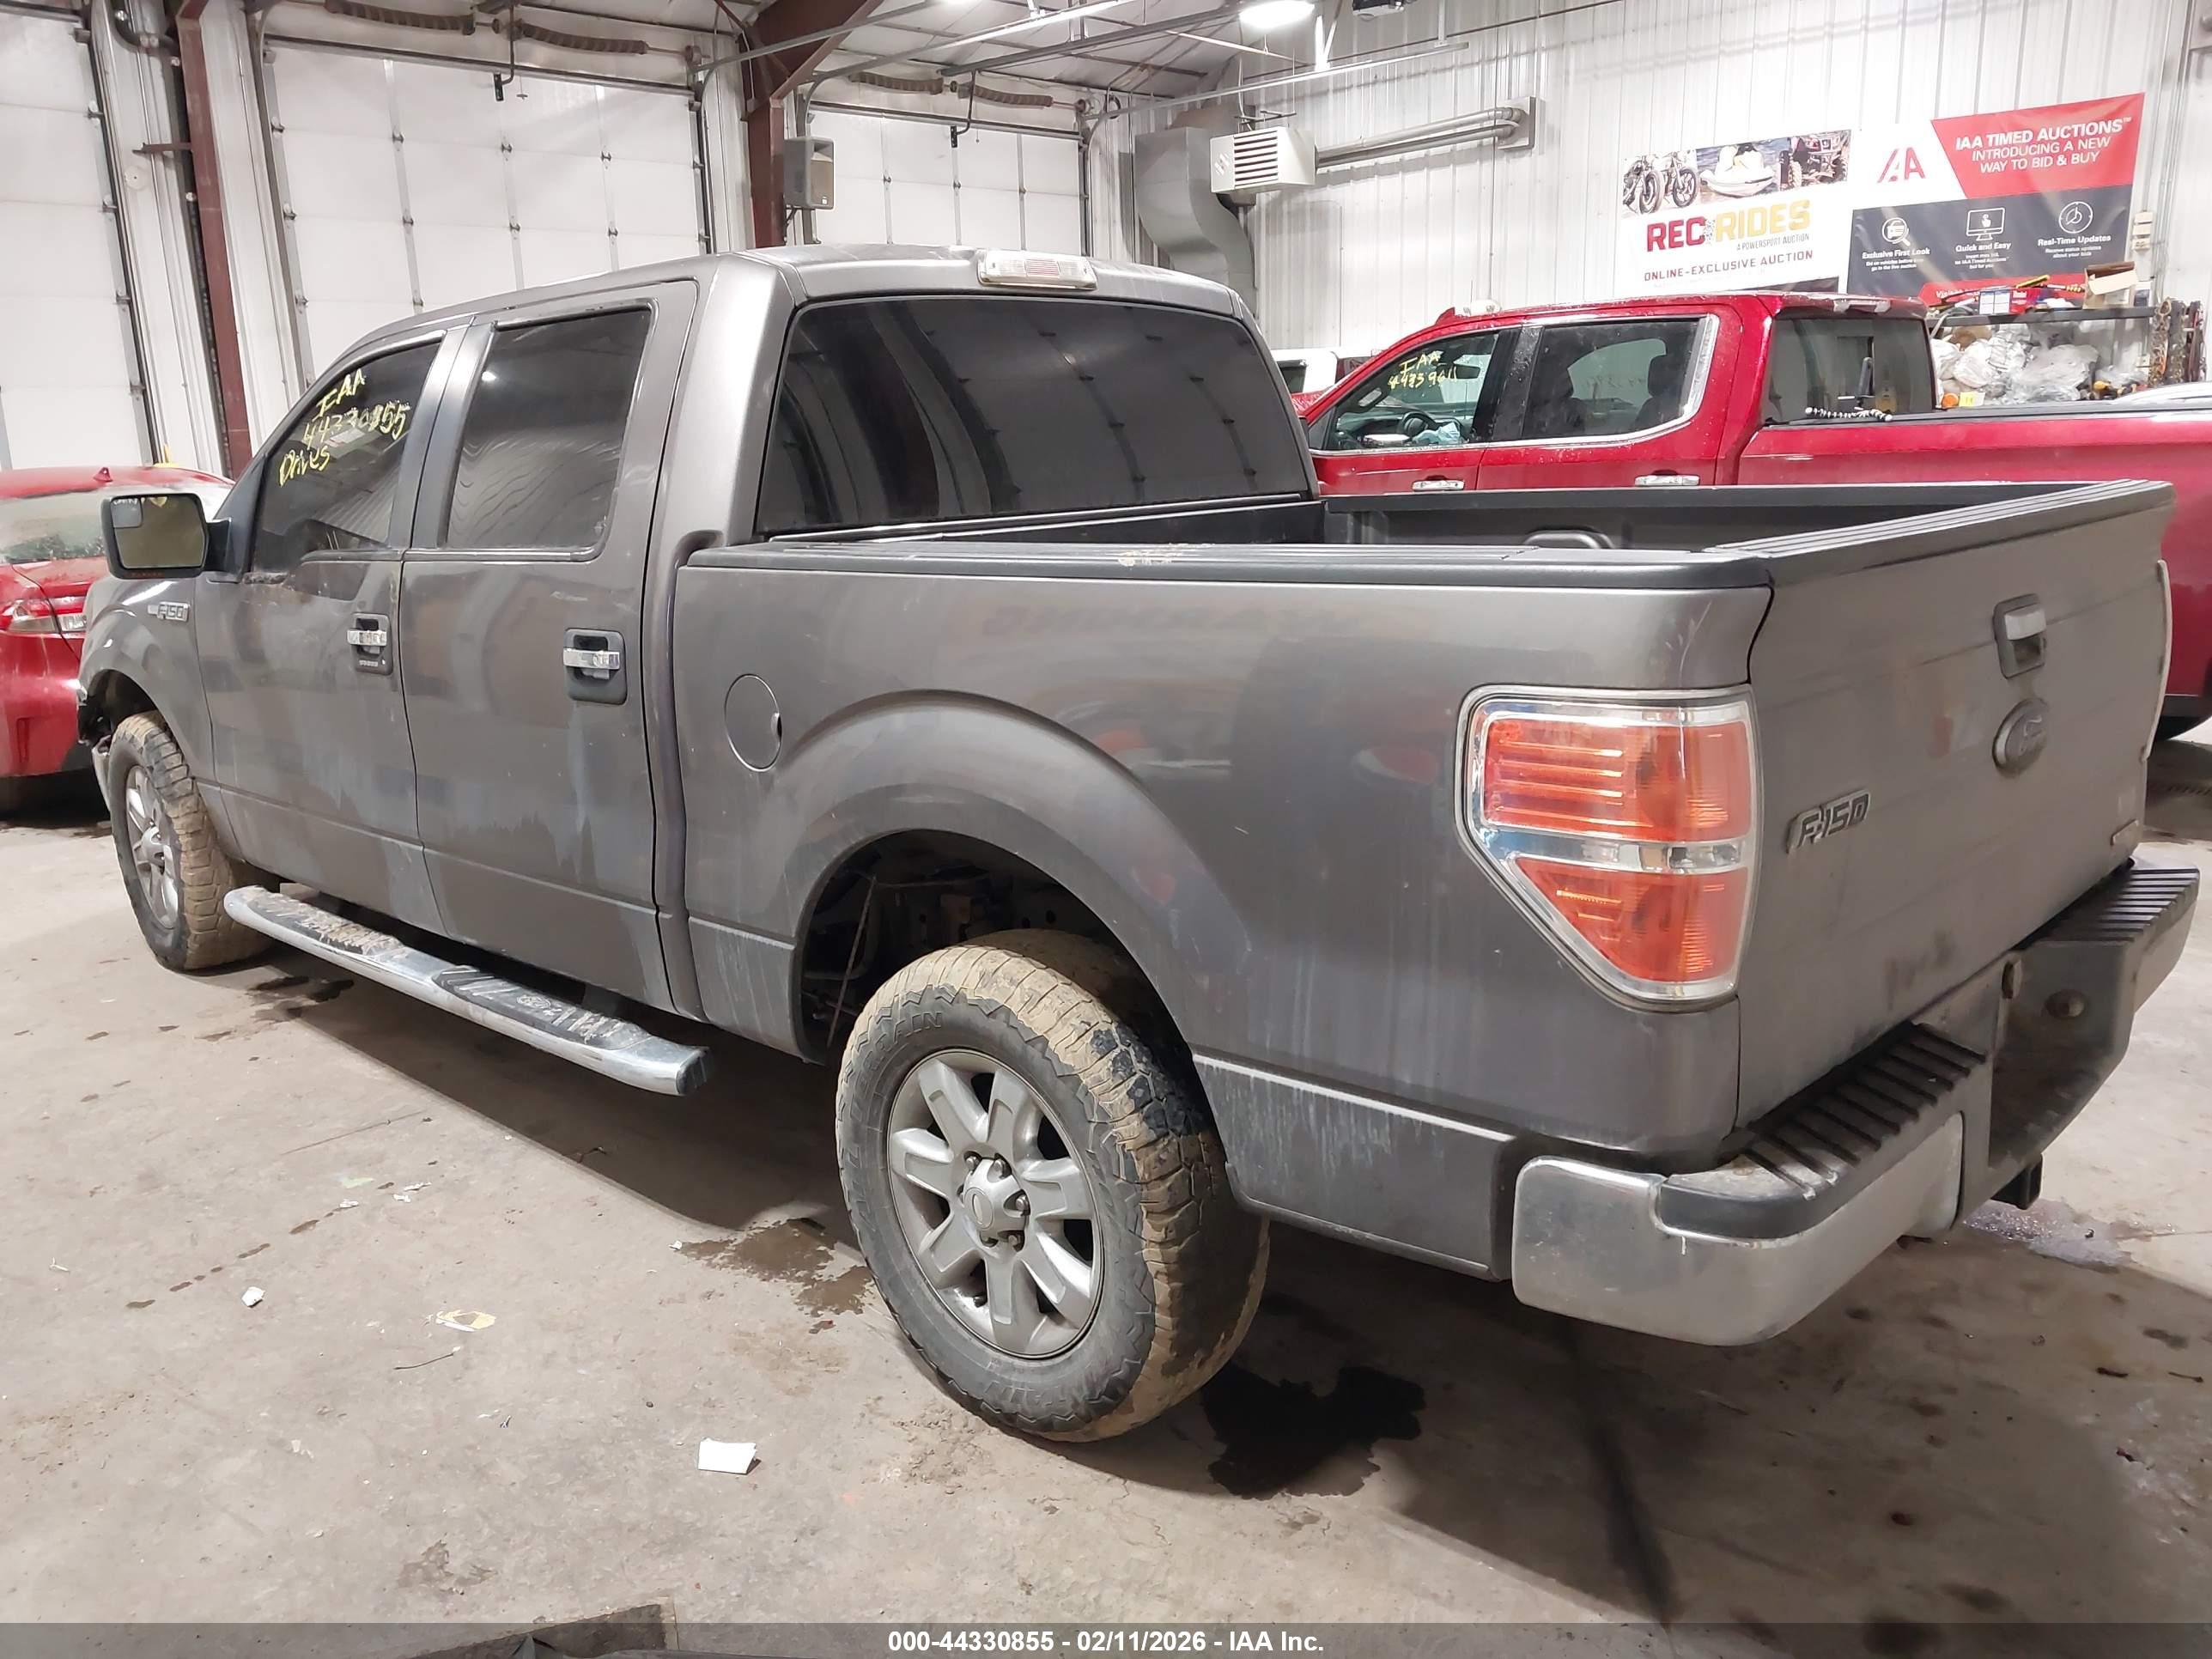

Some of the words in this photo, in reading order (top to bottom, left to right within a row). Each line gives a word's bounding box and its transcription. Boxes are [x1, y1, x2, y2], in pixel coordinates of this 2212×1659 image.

[1956, 136, 1983, 150] IAA
[1986, 130, 2033, 147] TIMED
[1972, 142, 2060, 161] INTRODUCING
[2063, 140, 2074, 152] A
[2078, 136, 2111, 150] NEW
[1980, 160, 2008, 173] WAY
[2011, 158, 2027, 170] TO
[2032, 155, 2053, 168] BID
[2057, 155, 2067, 166] &
[2071, 150, 2100, 165] BUY
[1647, 216, 1706, 252] REC
[1716, 199, 1811, 242] RIDES
[1741, 237, 1781, 251] POWERSPORT
[1783, 233, 1809, 245] AUCTION
[1911, 246, 1930, 256] Look
[1955, 244, 1978, 252] Quick
[1978, 242, 1993, 251] and
[1993, 241, 2011, 250] Easy
[2038, 237, 2076, 246] Real-Time
[2077, 235, 2112, 245] Updates
[1644, 258, 1756, 282] ONLINE-EXCLUSIVE
[1760, 250, 1813, 266] AUCTION
[313, 368, 367, 422] IAA
